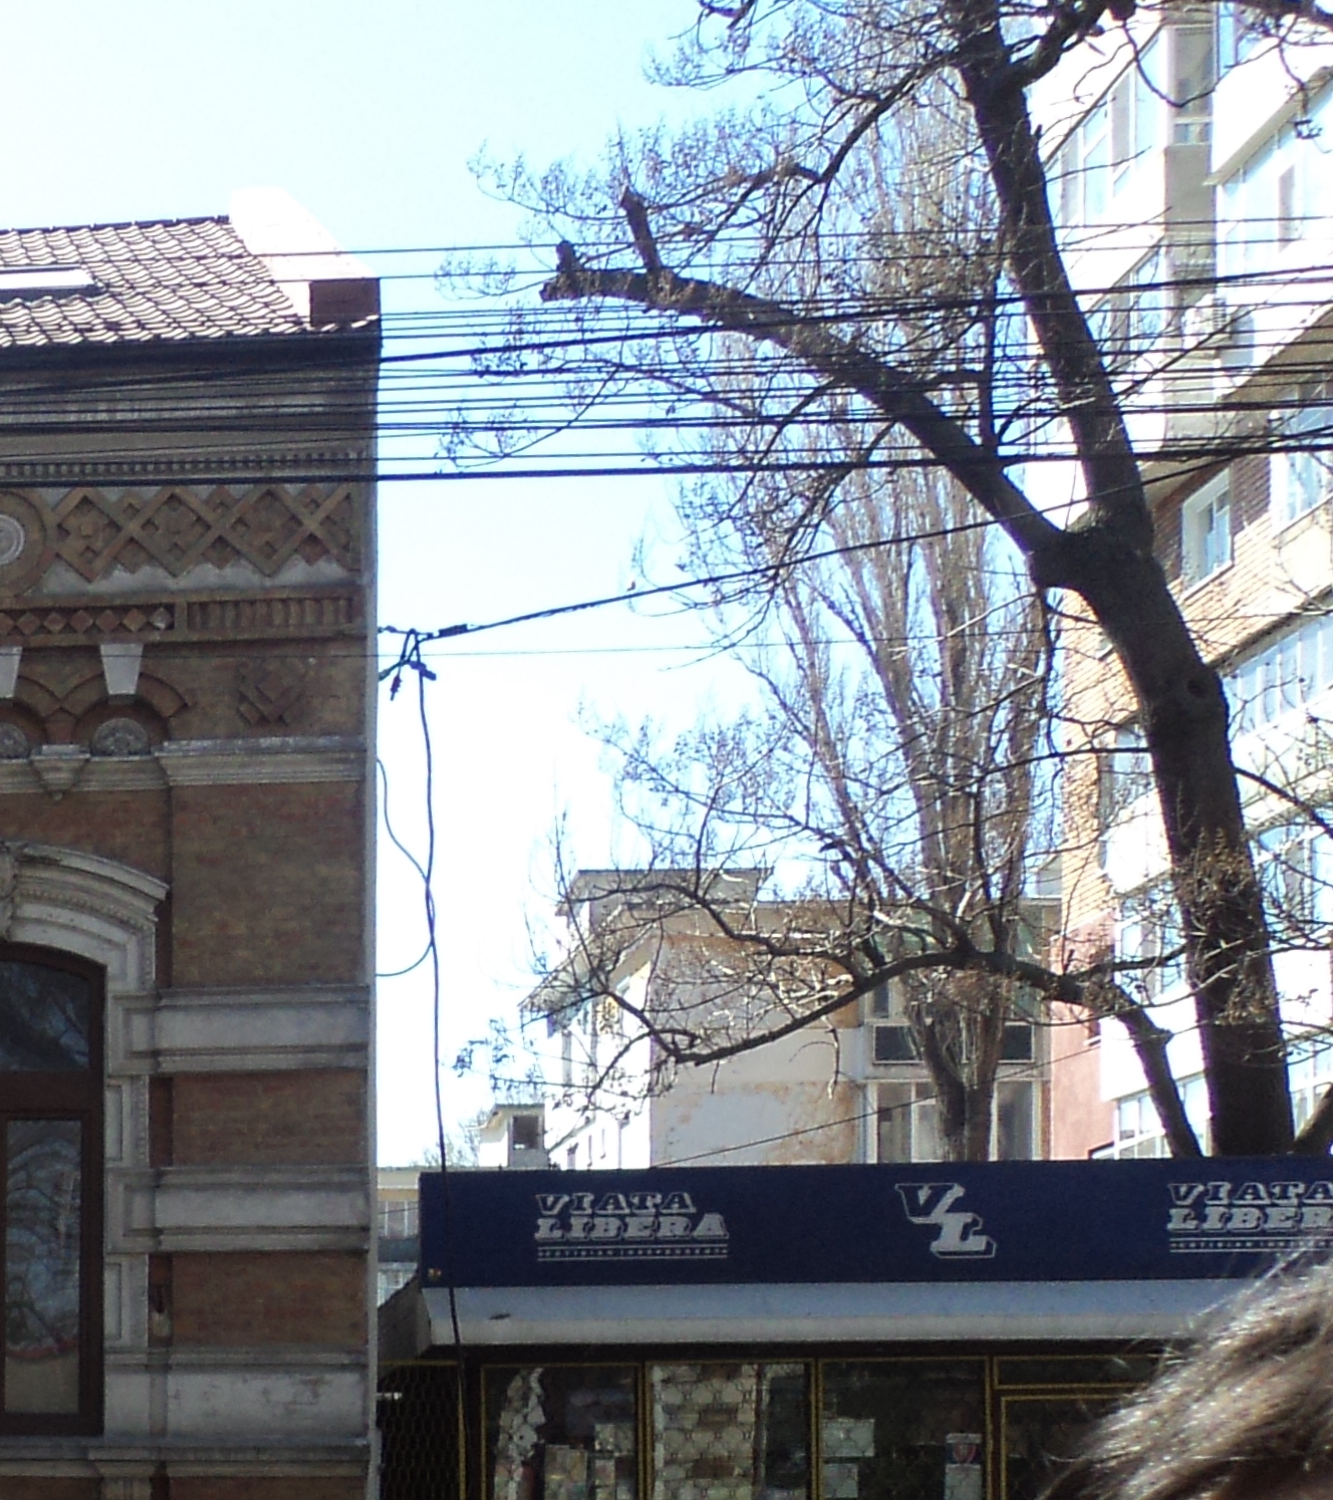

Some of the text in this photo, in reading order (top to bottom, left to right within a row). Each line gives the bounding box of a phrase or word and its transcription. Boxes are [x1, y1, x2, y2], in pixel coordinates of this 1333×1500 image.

[536, 1192, 696, 1215] VIATA
[534, 1213, 730, 1242] LIBERA
[1166, 1204, 1333, 1233] LIBER
